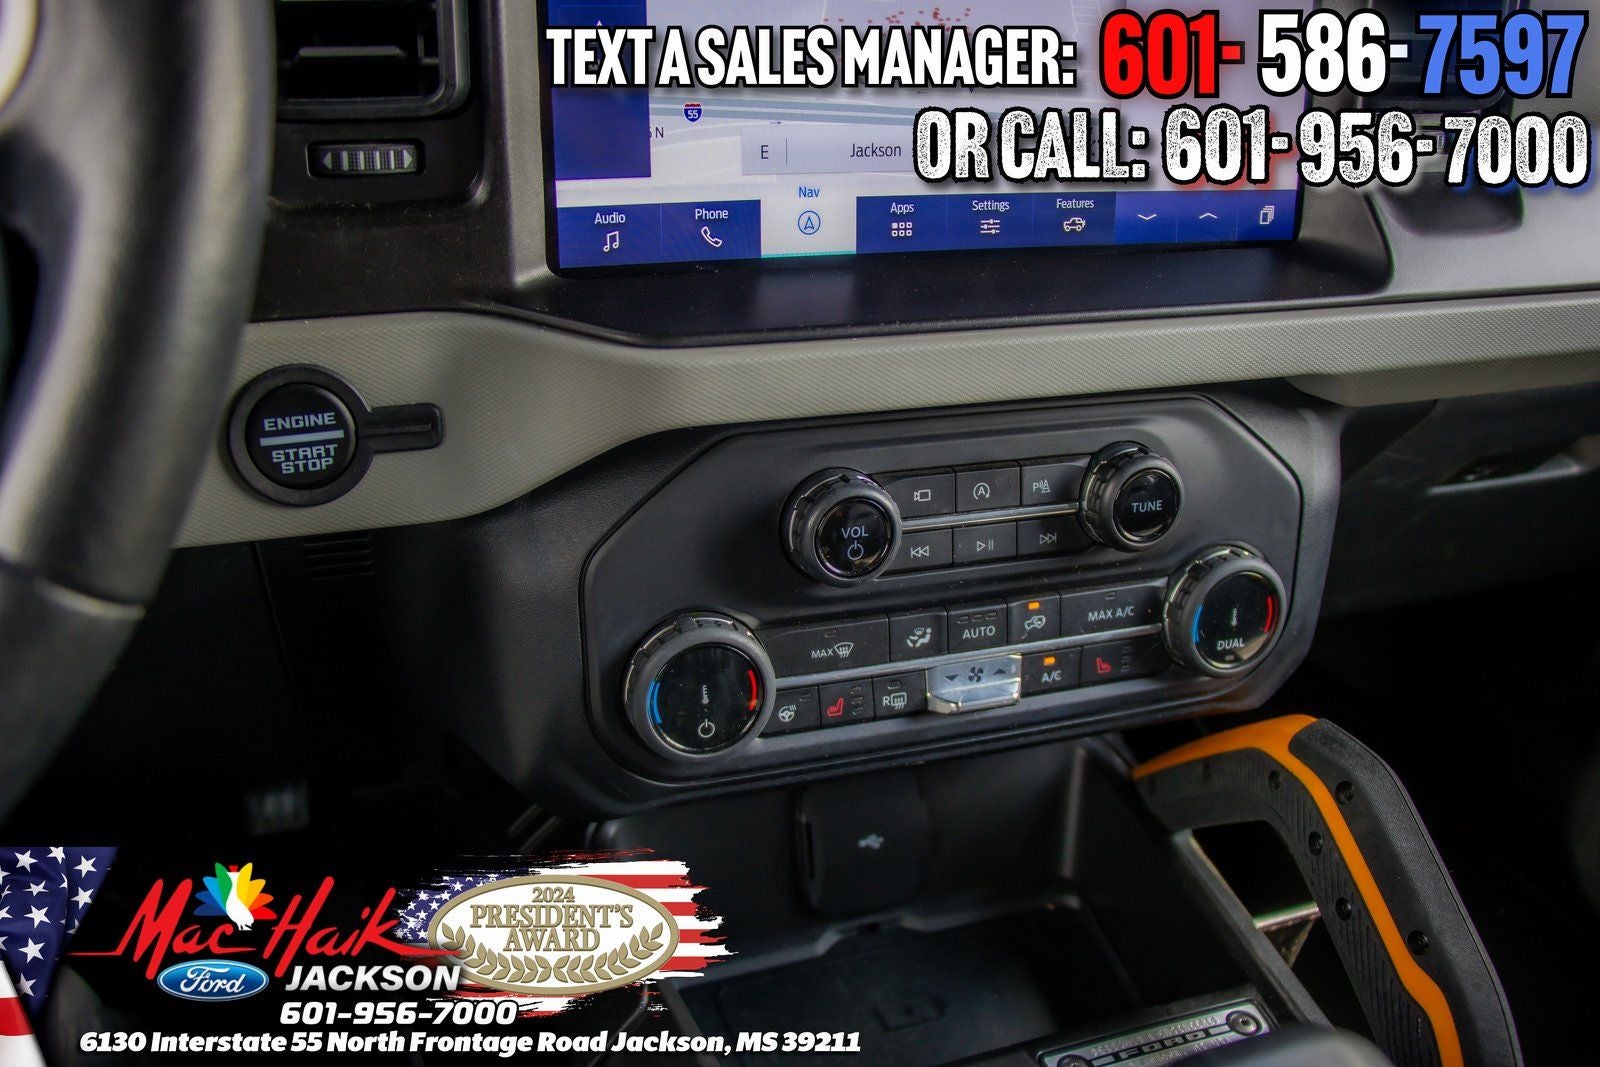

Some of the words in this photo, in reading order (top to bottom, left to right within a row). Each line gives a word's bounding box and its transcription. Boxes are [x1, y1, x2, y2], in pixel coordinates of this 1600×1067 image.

[687, 109, 699, 119] 55
[760, 144, 769, 159] E
[849, 142, 902, 159] Jackson
[798, 186, 821, 199] Nav
[890, 201, 915, 216] Apps
[971, 198, 1010, 213] Settings
[1056, 197, 1095, 210] Features
[594, 211, 626, 225] Audio
[694, 207, 729, 221] Phone
[264, 411, 336, 432] ENGINE
[272, 443, 338, 463] START
[281, 457, 334, 475] STOP
[1131, 497, 1163, 514] TUNE
[841, 525, 869, 539] VOL
[1088, 607, 1110, 622] MAX
[1110, 604, 1136, 619] A/C
[962, 624, 996, 641] AUTO
[1216, 635, 1246, 651] DUAL
[811, 647, 834, 660] MAX
[1041, 668, 1062, 684] A/C
[1119, 1031, 1207, 1061] FORD
